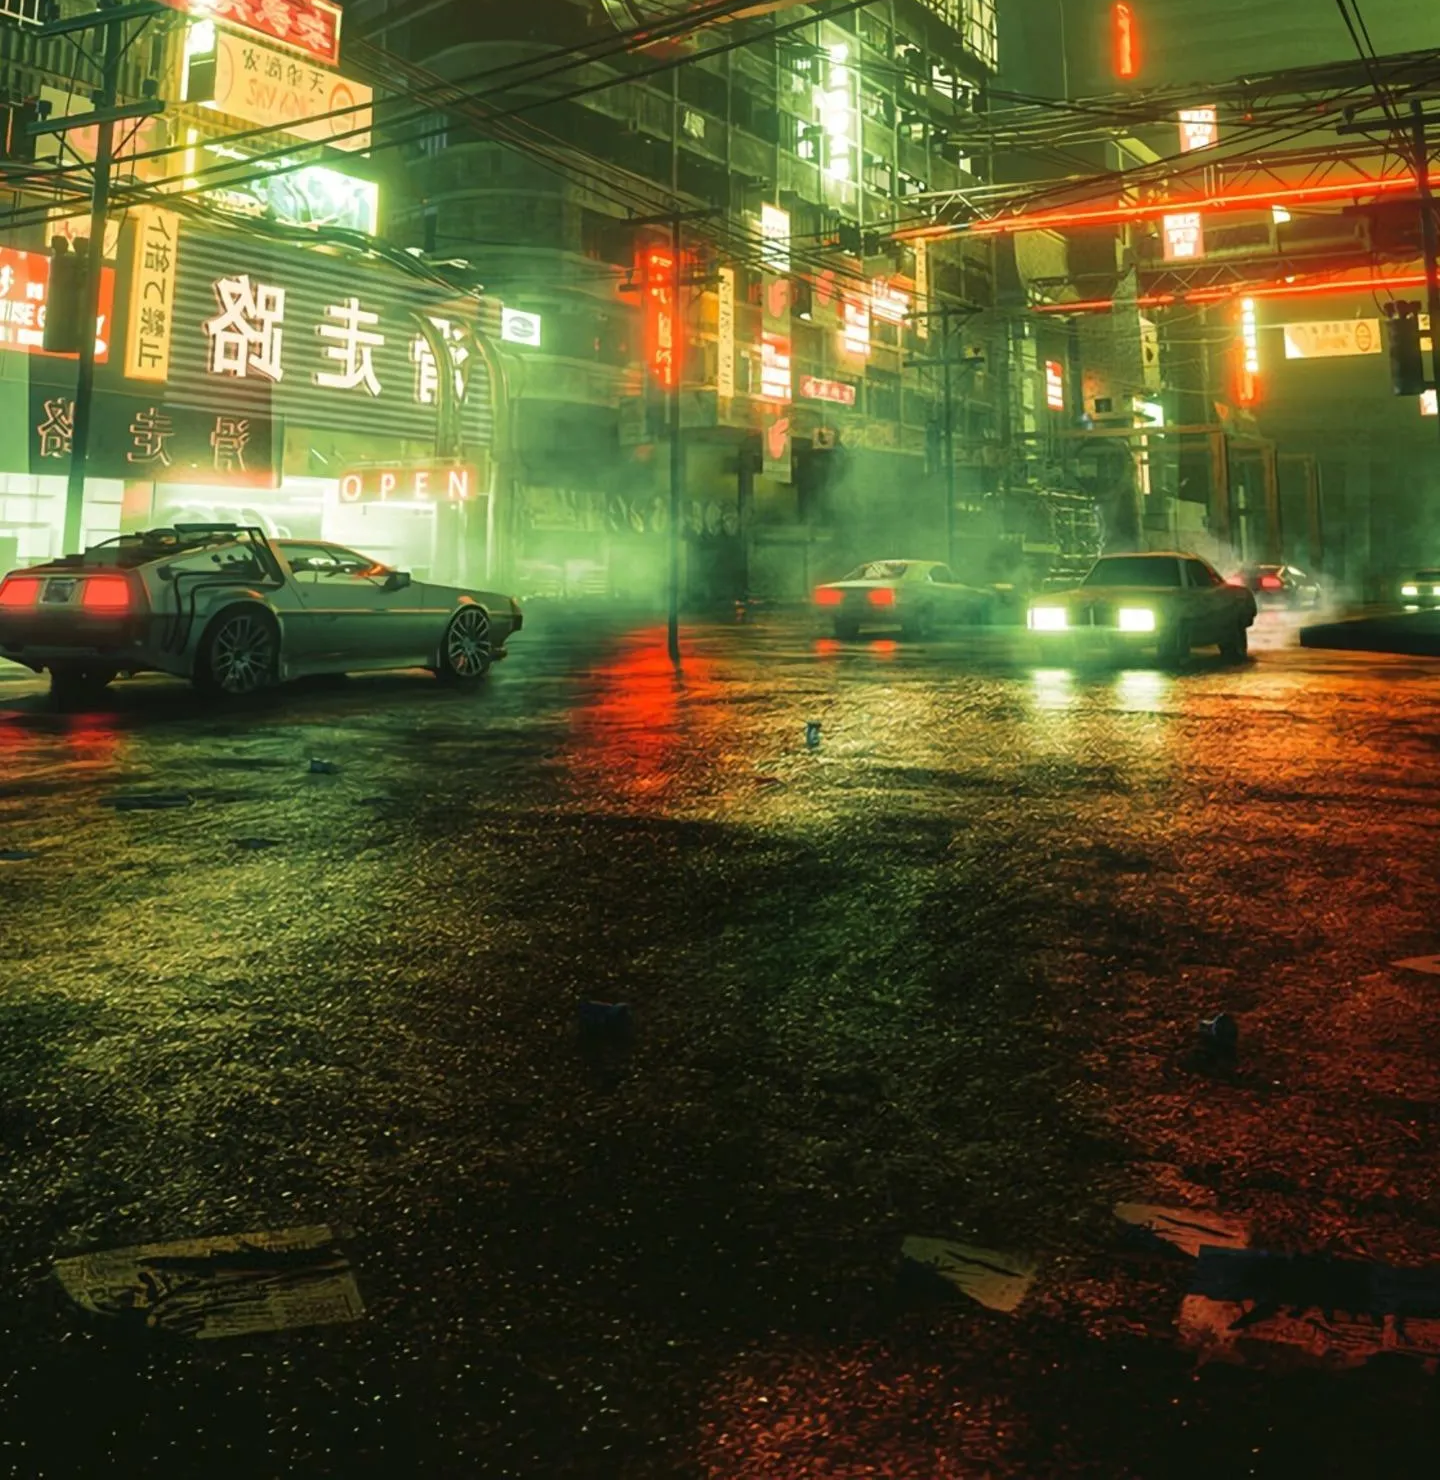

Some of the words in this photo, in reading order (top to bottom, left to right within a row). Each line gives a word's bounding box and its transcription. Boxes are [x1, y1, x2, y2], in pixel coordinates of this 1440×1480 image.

[138, 213, 172, 368] イ捨て禁止
[341, 470, 469, 502] OPEN
